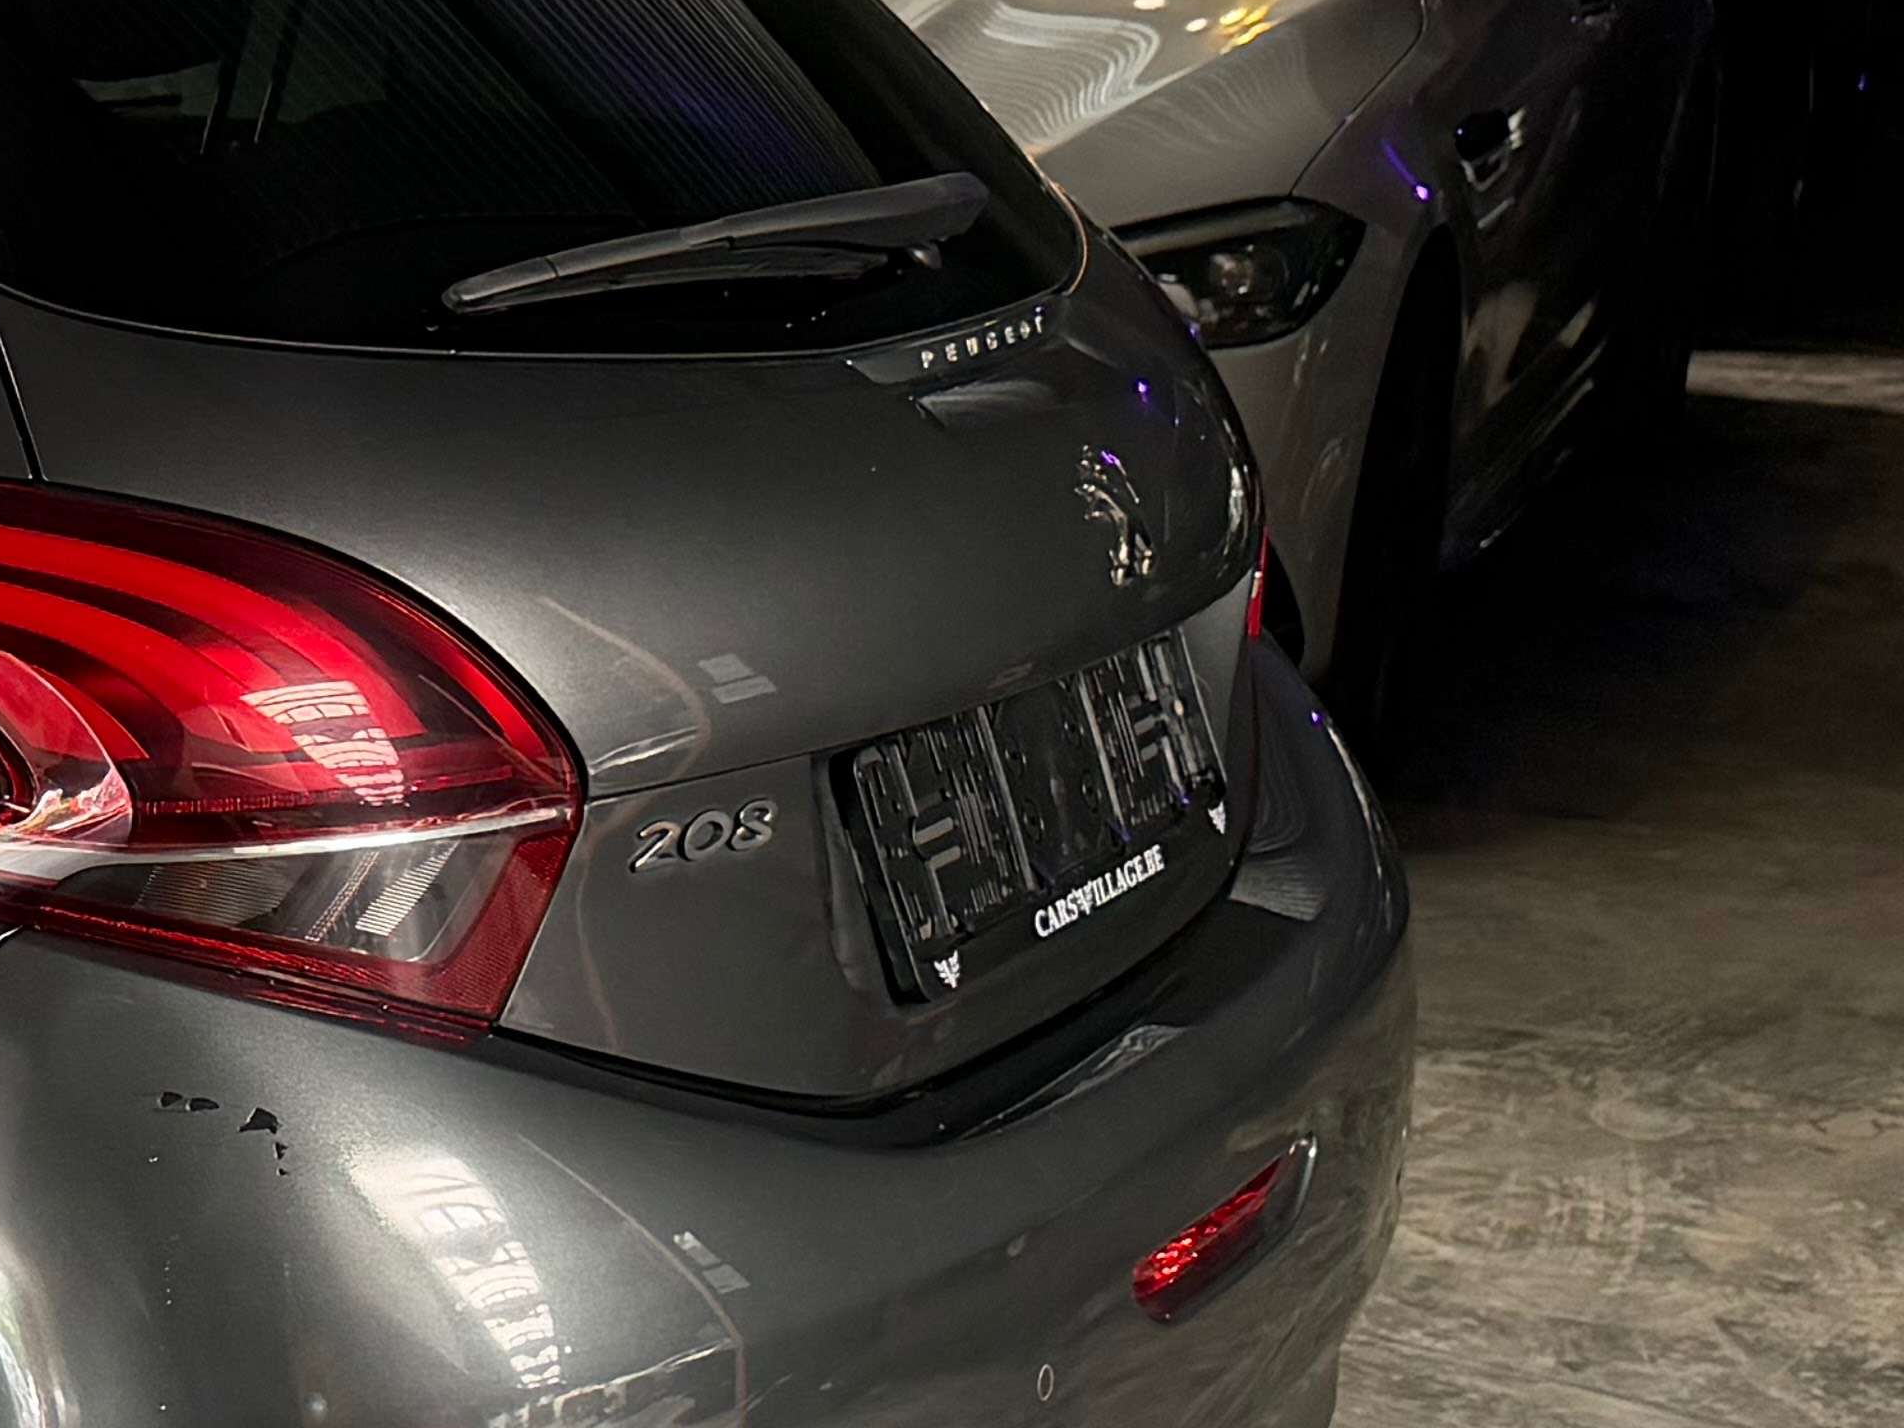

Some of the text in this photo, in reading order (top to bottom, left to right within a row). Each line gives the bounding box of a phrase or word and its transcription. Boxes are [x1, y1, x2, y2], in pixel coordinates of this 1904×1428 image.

[921, 306, 1043, 369] PEUGEOT
[627, 797, 778, 874] 208
[1034, 843, 1166, 939] CARSVILLAGE.BE
